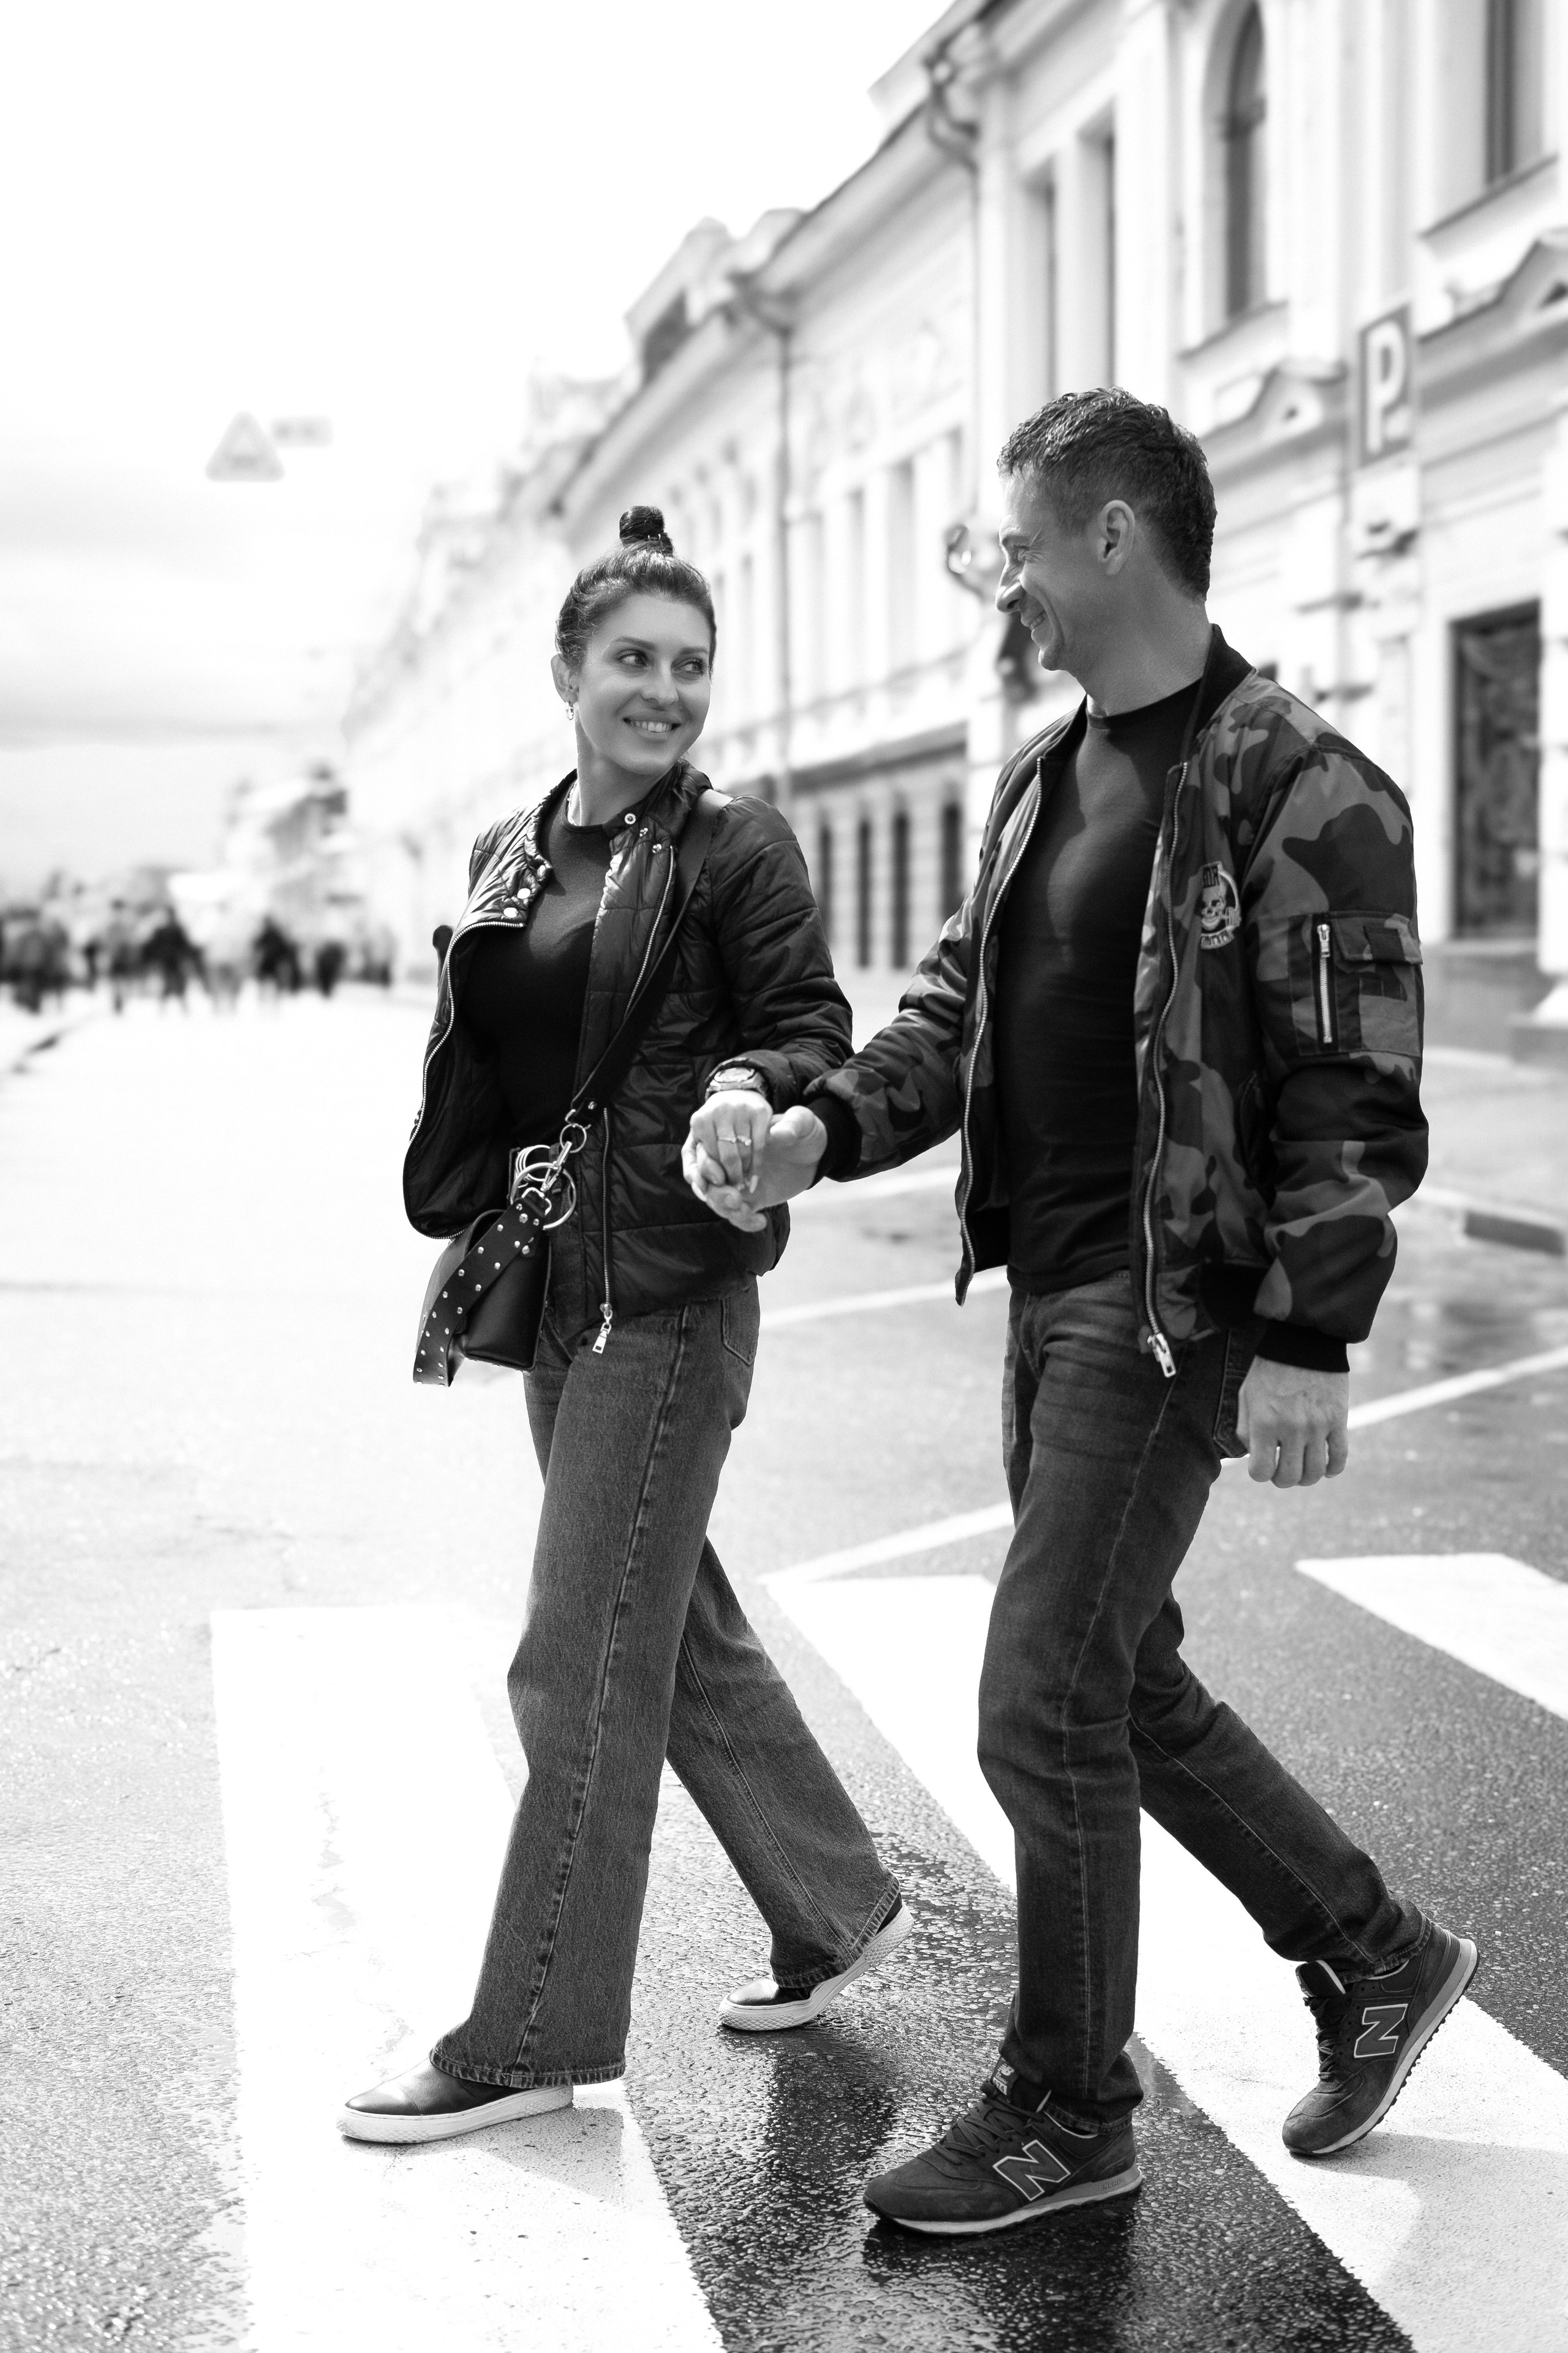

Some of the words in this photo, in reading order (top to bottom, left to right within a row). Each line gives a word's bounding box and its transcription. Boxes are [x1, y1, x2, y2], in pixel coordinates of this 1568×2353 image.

[1366, 321, 1403, 452] P
[1354, 2004, 1408, 2058] N
[993, 2140, 1071, 2201] N
